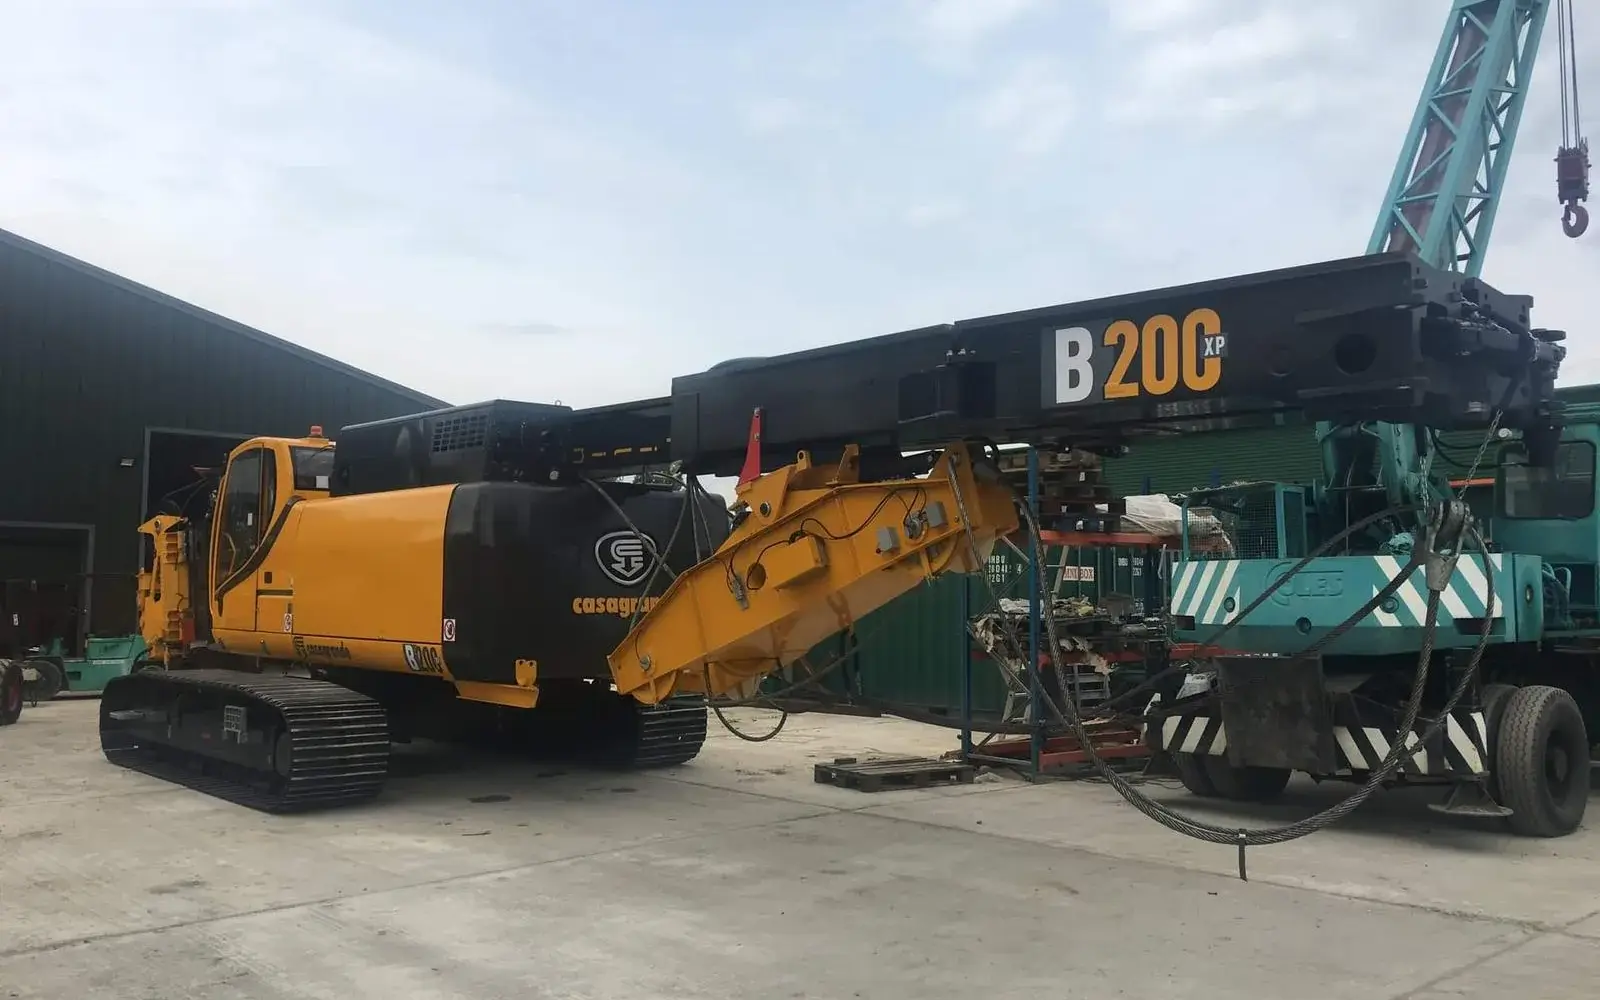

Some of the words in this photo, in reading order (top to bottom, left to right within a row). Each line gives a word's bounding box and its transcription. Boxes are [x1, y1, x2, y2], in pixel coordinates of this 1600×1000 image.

[1204, 335, 1225, 356] XP
[1055, 327, 1093, 404] B
[1080, 568, 1094, 579] BOX
